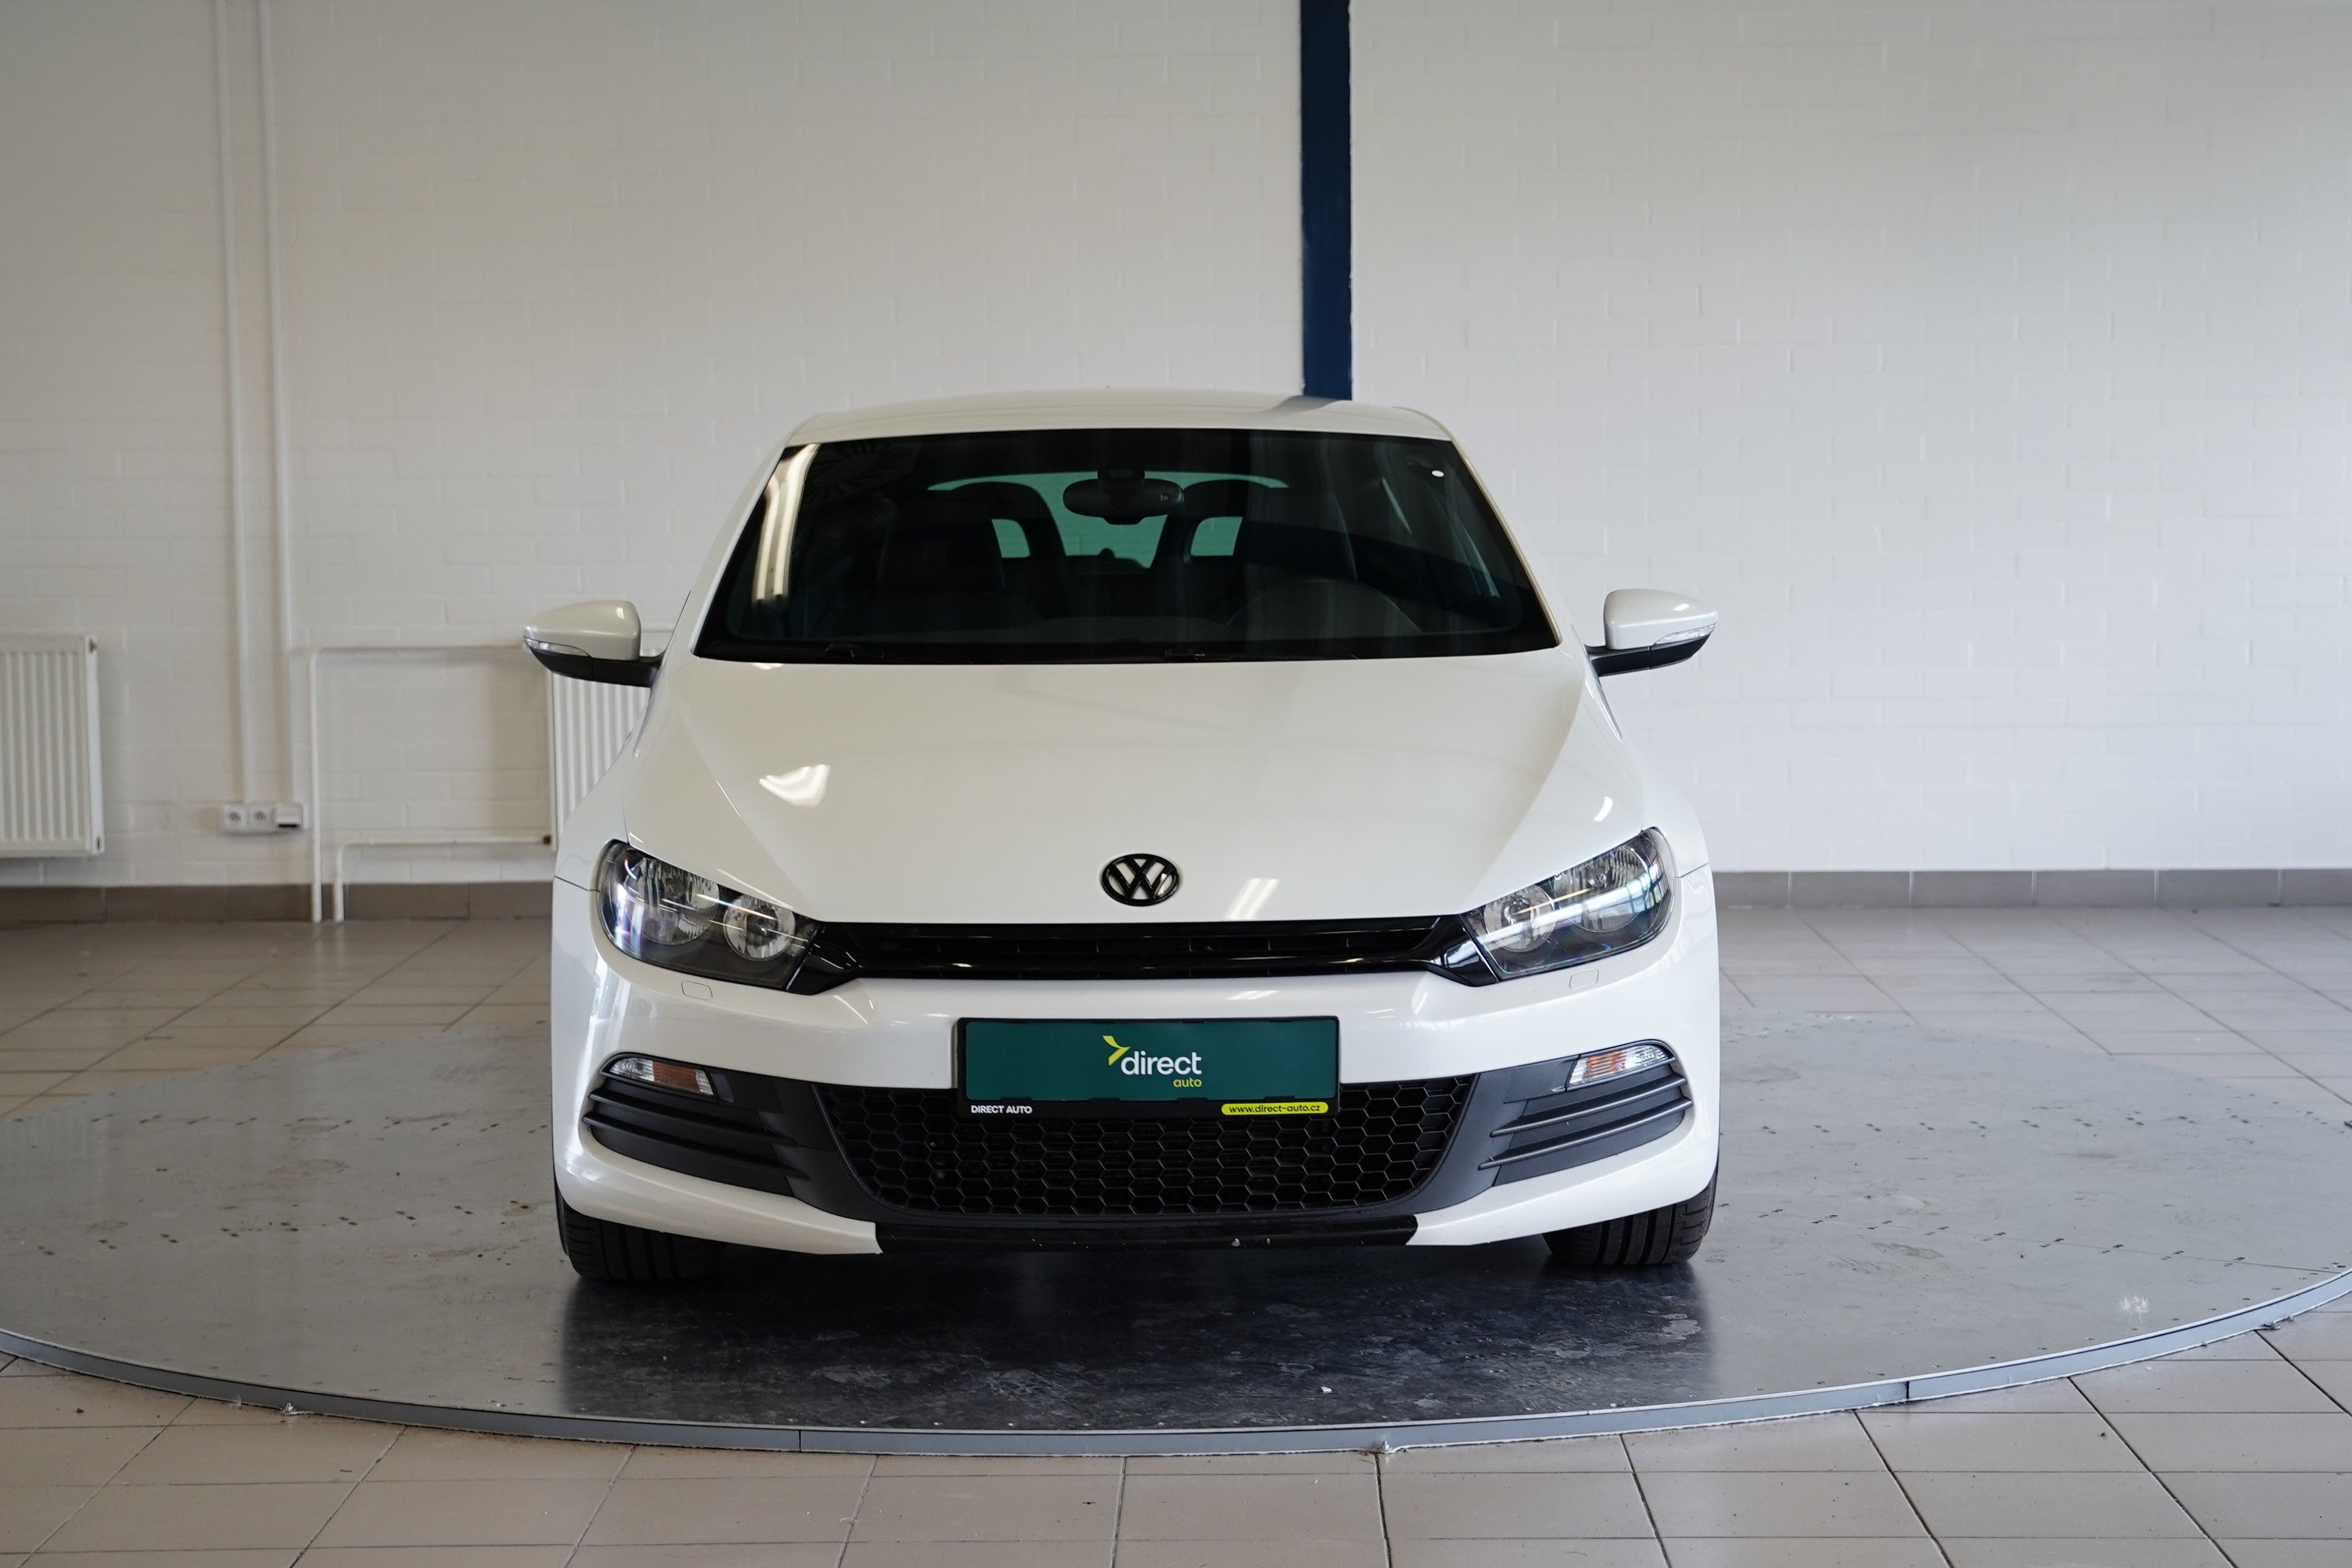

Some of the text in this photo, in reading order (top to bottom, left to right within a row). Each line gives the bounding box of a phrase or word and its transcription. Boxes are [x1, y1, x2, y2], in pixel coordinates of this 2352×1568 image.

[1103, 854, 1178, 906] VW
[1121, 1050, 1202, 1075] direct
[1173, 1077, 1202, 1087] auto
[970, 1105, 1033, 1114] DIRECT AUTO
[1229, 1104, 1321, 1113] www.direct-auto.cz
